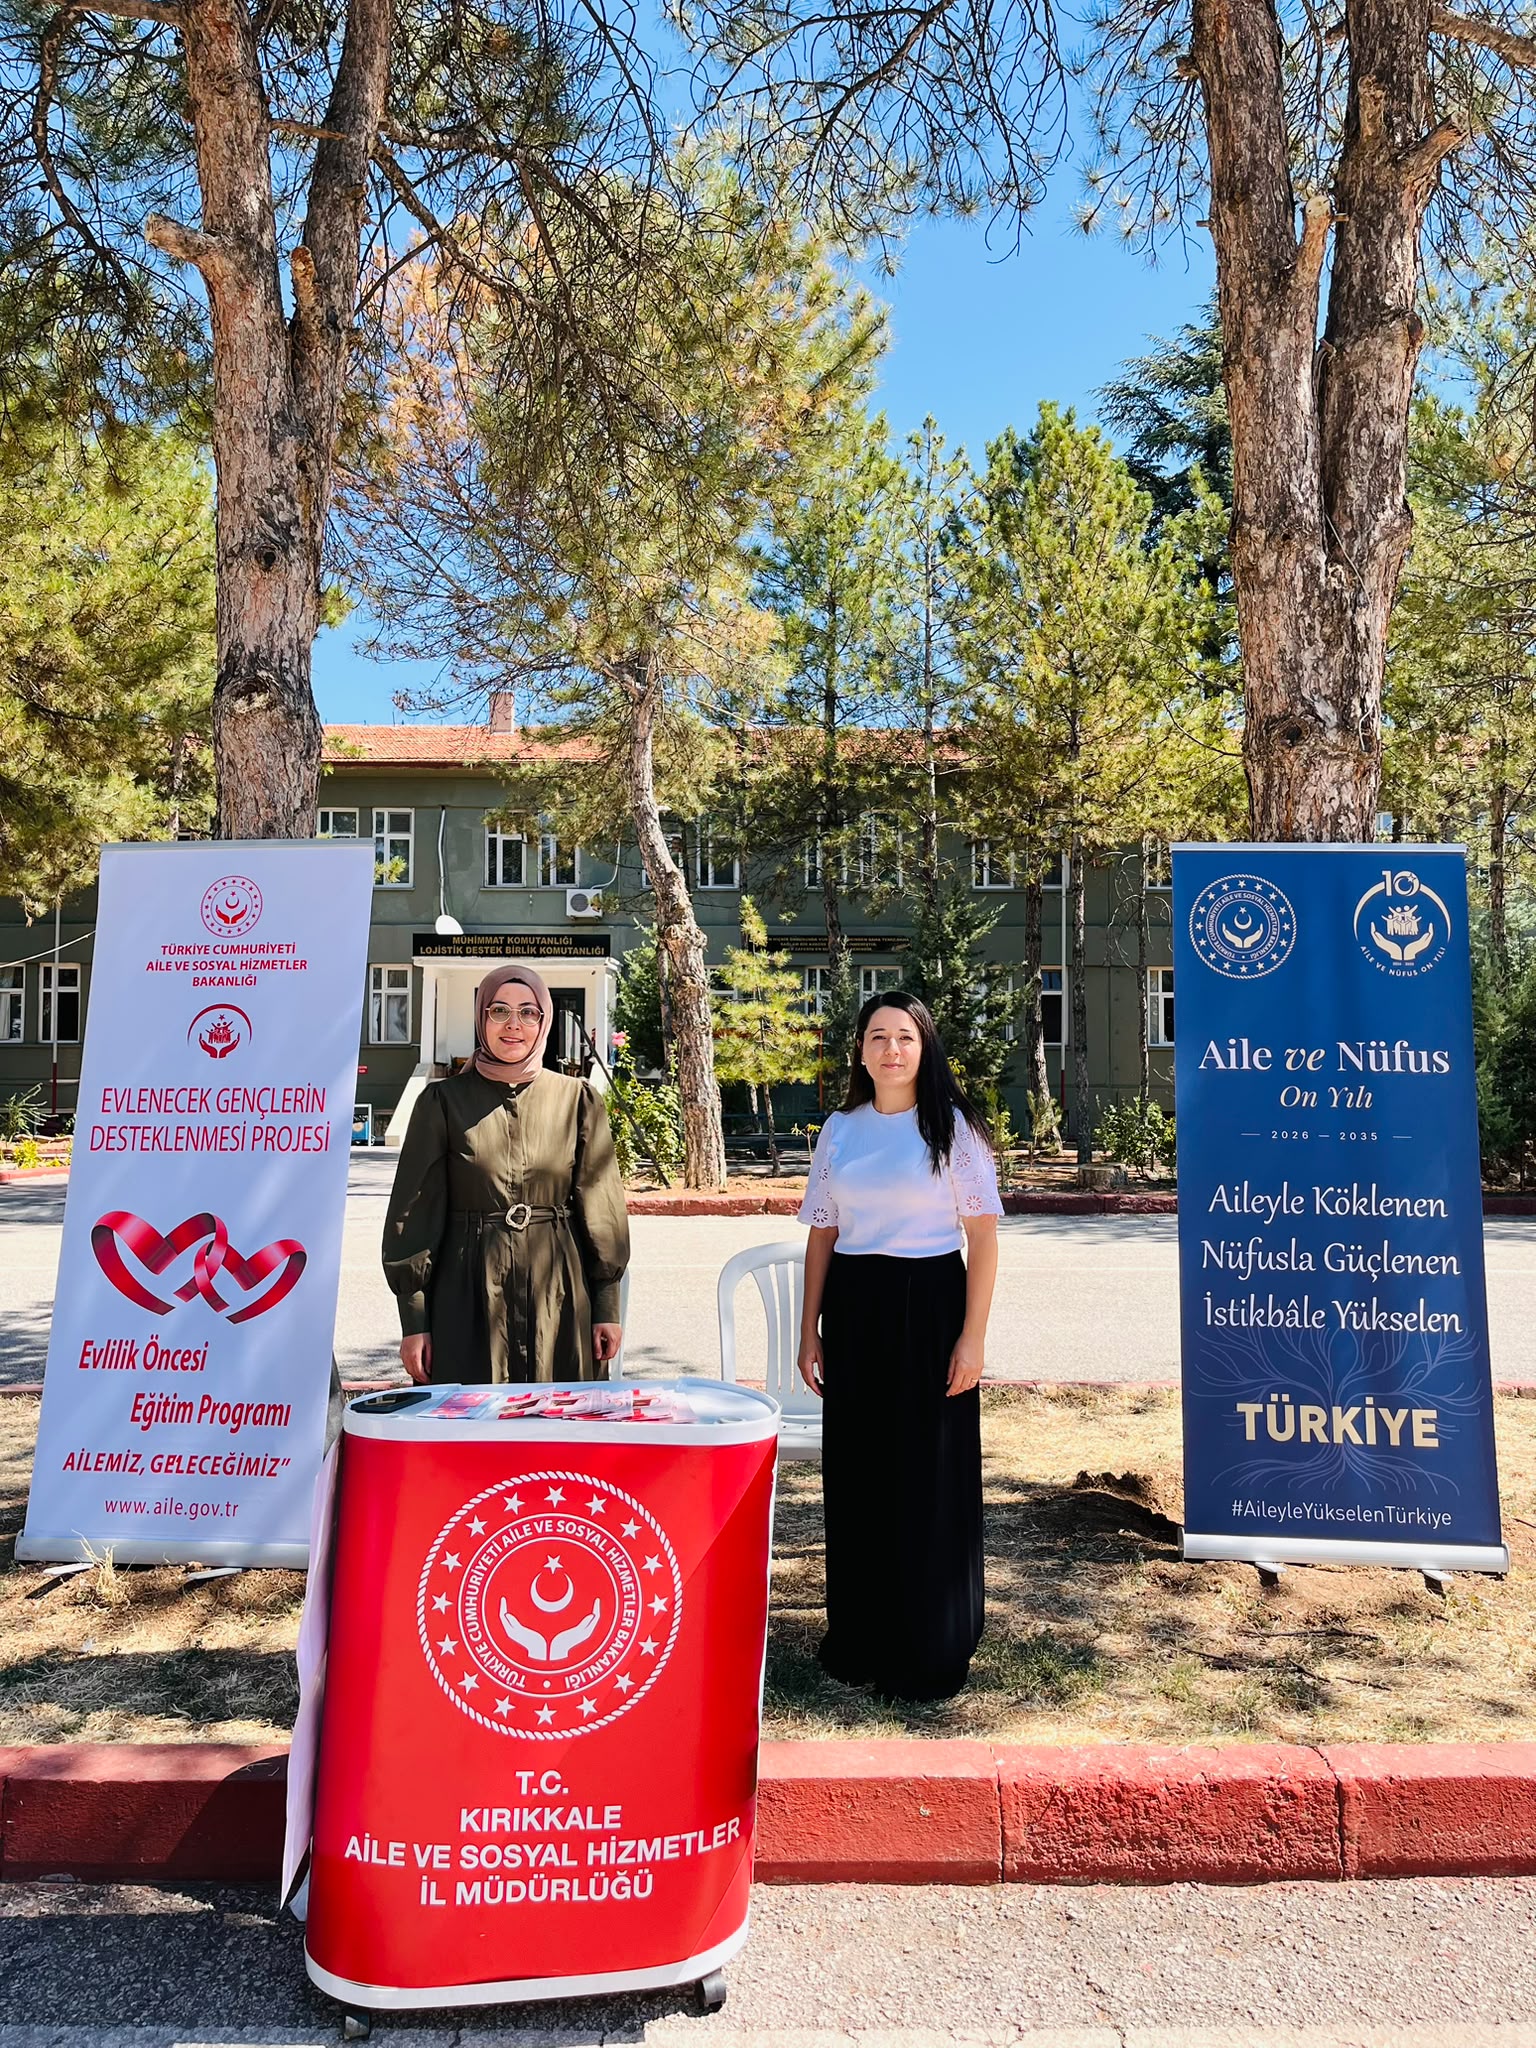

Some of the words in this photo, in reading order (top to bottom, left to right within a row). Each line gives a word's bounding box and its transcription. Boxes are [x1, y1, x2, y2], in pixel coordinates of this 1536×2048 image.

[161, 942, 210, 956] TÜRKİYE
[212, 943, 296, 955] CUMHURİYETİ
[420, 945, 463, 955] LOJİSTİK
[466, 946, 503, 954] DESTEK
[505, 945, 537, 954] BİRLİK
[540, 946, 605, 955] KOMUTANLIĞI
[452, 935, 505, 945] MÜHİMMAT
[507, 936, 573, 945] KOMUTANLIĞI
[145, 960, 172, 972] AİLE
[174, 960, 190, 972] VE
[192, 960, 238, 971] SOSYAL
[239, 958, 308, 971] HİZMETLER
[1360, 945, 1375, 963] AİLE
[1376, 962, 1386, 972] VE
[1389, 968, 1418, 977] NÜFUS
[1421, 962, 1433, 973] ON
[1433, 946, 1446, 962] YILI
[192, 974, 257, 988] BAKANLIĞI
[1198, 1038, 1272, 1071] Aile
[1284, 1048, 1326, 1071] ve
[1336, 1040, 1450, 1074] Nüfus
[101, 1087, 212, 1115] EVLENECEK
[215, 1082, 326, 1121] GENÇLERİN
[1280, 1085, 1318, 1108] On
[1328, 1085, 1372, 1109] Yılı
[89, 1122, 247, 1153] DESTEKLENMESİ
[251, 1118, 331, 1153] PROJESİ
[1271, 1129, 1309, 1140] 2026
[1339, 1131, 1378, 1141] 2035
[1208, 1180, 1305, 1225] Aileyle
[1311, 1182, 1449, 1218] Köklenen
[1200, 1236, 1317, 1281] Nüfusla
[1323, 1239, 1462, 1283] Güçlenen
[1203, 1291, 1326, 1329] İstikbâle
[1331, 1296, 1463, 1334] Yükselen
[78, 1339, 140, 1371] Evlilik
[142, 1334, 209, 1372] Öncesi
[130, 1392, 195, 1432] Eğitim
[197, 1393, 292, 1435] Programı
[1236, 1393, 1440, 1448] TÜRKİYE
[63, 1450, 145, 1475] AİLEMİZ,
[533, 1520, 553, 1534] VE
[1231, 1499, 1452, 1529] #AileyleYükselenTürkiye
[501, 1522, 532, 1549] AİLE
[556, 1520, 606, 1551] SOSYAL
[465, 1541, 502, 1642] CUMHURİYETİ
[607, 1547, 636, 1628] HİZMETLER
[475, 1643, 527, 1689] TÜRKİYE
[565, 1630, 631, 1689] BAKANLIĞI
[515, 1770, 569, 1795] T.C.
[460, 1805, 622, 1833] KIRIKKALE
[344, 1832, 406, 1867] AİLE
[413, 1843, 451, 1869] VE
[459, 1843, 578, 1870] SOSYAL
[585, 1816, 741, 1866] HİZMETLER
[420, 1875, 447, 1906] İL
[455, 1870, 653, 1905] MÜDÜRLÜĞÜ
